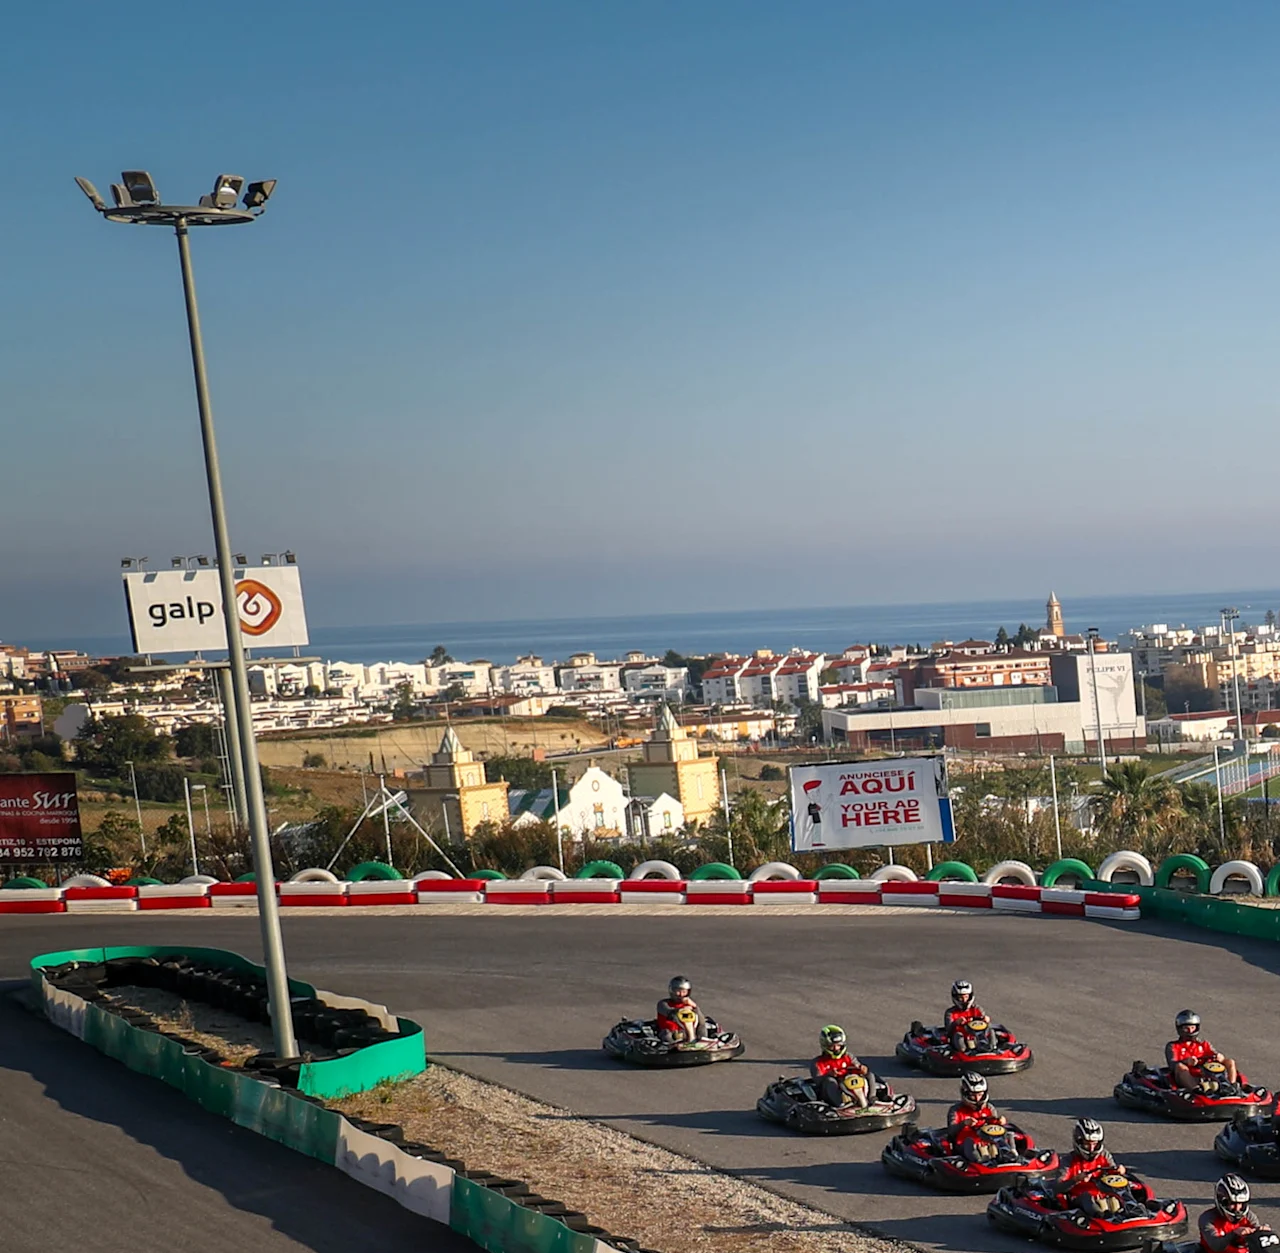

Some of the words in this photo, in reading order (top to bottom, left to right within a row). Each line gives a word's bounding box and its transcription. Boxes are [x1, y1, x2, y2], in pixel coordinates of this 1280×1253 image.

[148, 596, 214, 627] galp
[839, 770, 904, 781] ANUNCIESE
[840, 771, 916, 796] AQUÍ
[32, 791, 75, 809] Sur
[841, 801, 889, 812] YOUR
[895, 799, 919, 809] AD
[842, 808, 921, 828] HERE
[36, 838, 82, 846] ESTEPONA
[13, 847, 35, 858] 952
[61, 847, 82, 857] 876
[1260, 1235, 1280, 1247] 24
